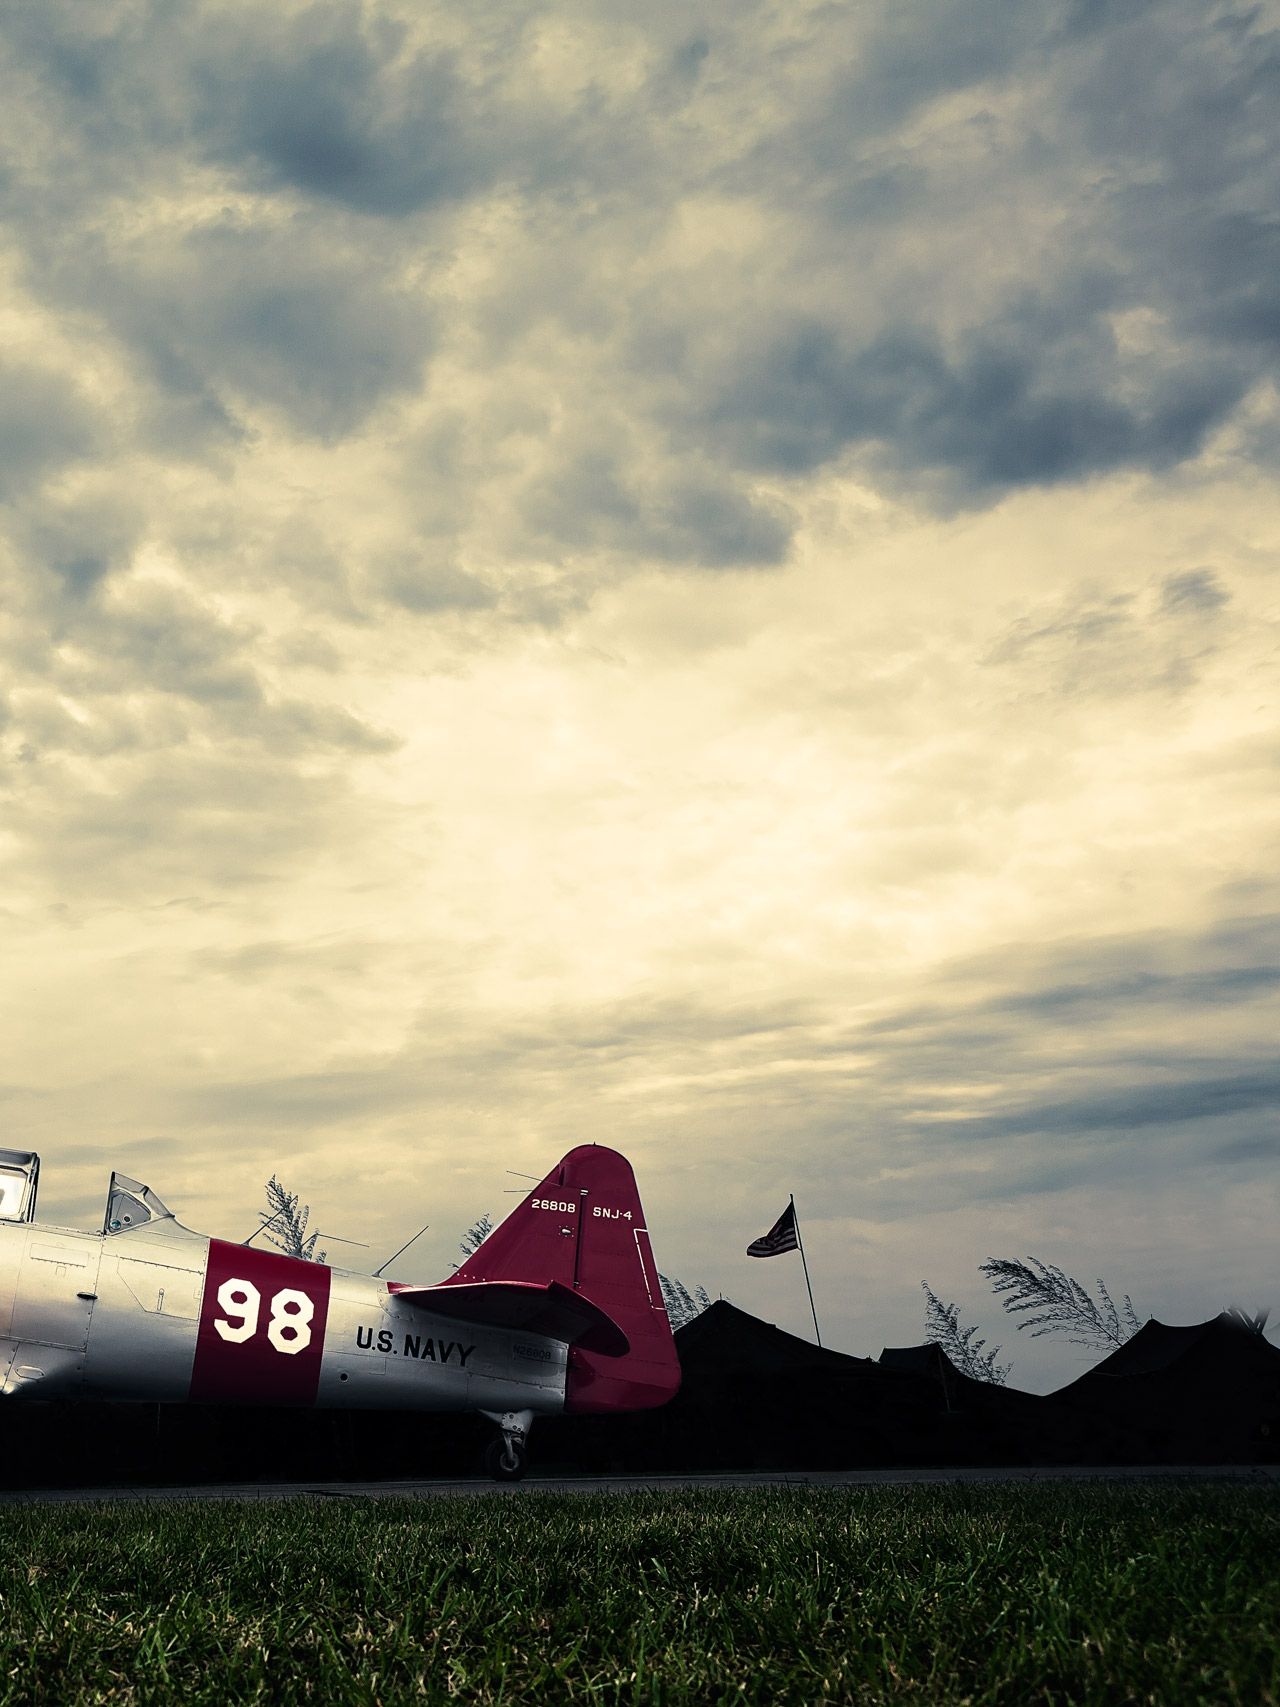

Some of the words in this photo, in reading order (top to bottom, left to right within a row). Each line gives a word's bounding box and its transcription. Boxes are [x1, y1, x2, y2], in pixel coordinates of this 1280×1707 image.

[531, 1198, 576, 1213] 26808
[592, 1206, 633, 1220] SNJ-4
[214, 1277, 315, 1355] 98
[356, 1326, 398, 1354] U.S.
[404, 1334, 476, 1367] NAVY
